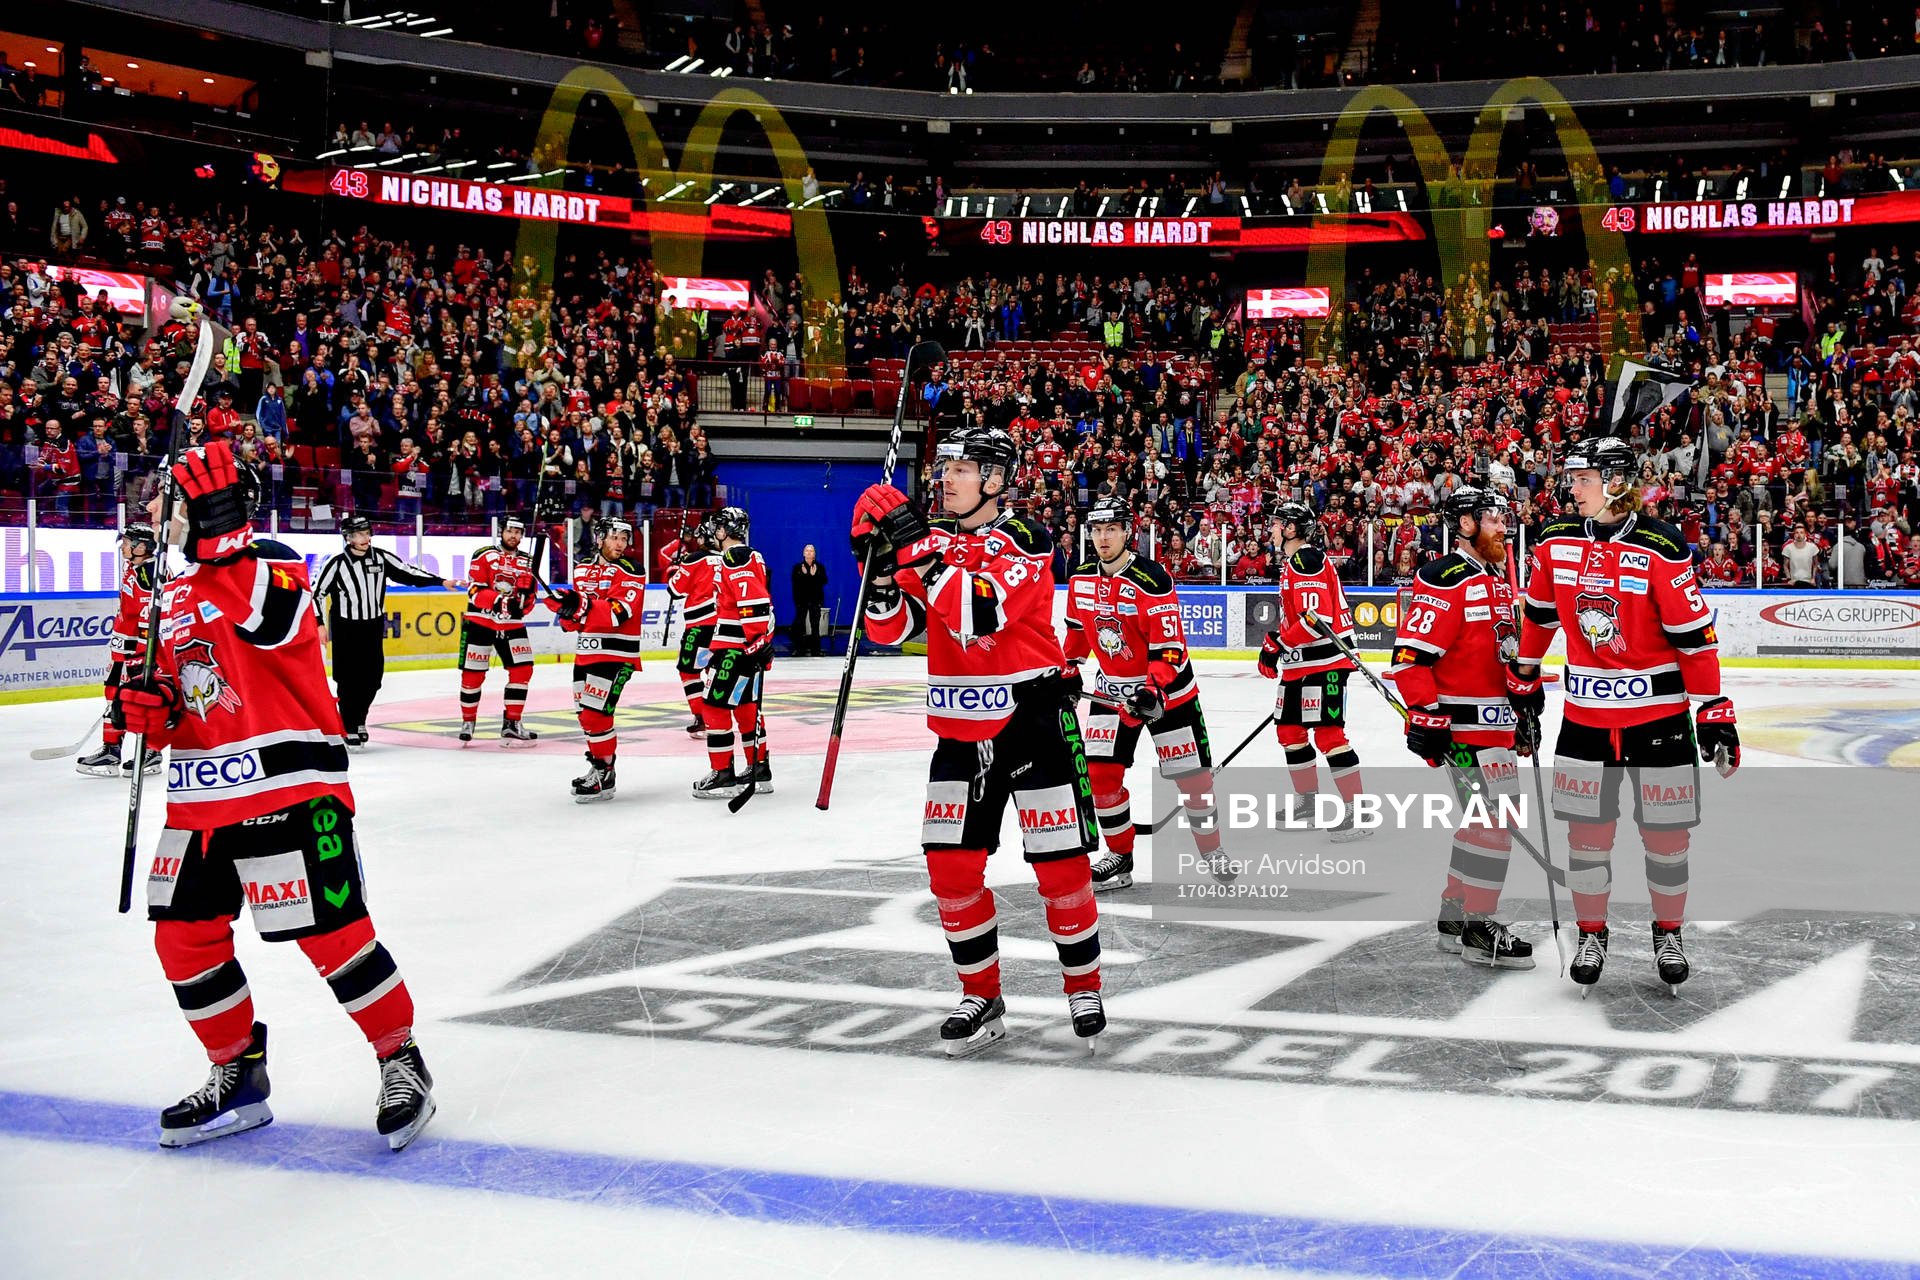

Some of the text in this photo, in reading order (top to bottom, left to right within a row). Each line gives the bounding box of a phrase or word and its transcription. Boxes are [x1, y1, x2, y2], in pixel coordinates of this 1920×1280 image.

[330, 169, 601, 222] 43 NICHLAS HARDT
[1601, 199, 1855, 232] 43 NICHLAS HARDT
[981, 221, 1211, 244] 43 NICHLAS HARDT
[625, 590, 636, 602] 9
[738, 581, 748, 598] 7
[1301, 592, 1319, 610] 10
[139, 606, 150, 620] 4
[1406, 607, 1437, 634] 28
[1784, 607, 1914, 622] HAGA GRUPPEN
[37, 616, 116, 639] CARGO
[1161, 615, 1178, 638] 57
[53, 667, 105, 680] WORLDWI
[930, 686, 1008, 710] areco
[1569, 676, 1648, 698] areco
[1707, 708, 1736, 720] CC
[1062, 711, 1092, 798] akea
[1158, 742, 1197, 759] MAXI
[168, 753, 256, 788] areco
[1554, 771, 1600, 795] MAXI
[1642, 784, 1694, 802] MAXI
[242, 812, 290, 827] CCM
[925, 800, 965, 820] MAXI
[1019, 807, 1078, 829] MAXI
[1030, 824, 1077, 835] STORMARKNAD
[243, 878, 309, 904] MAXI
[612, 999, 1898, 1112] SLUSPEL 2017
